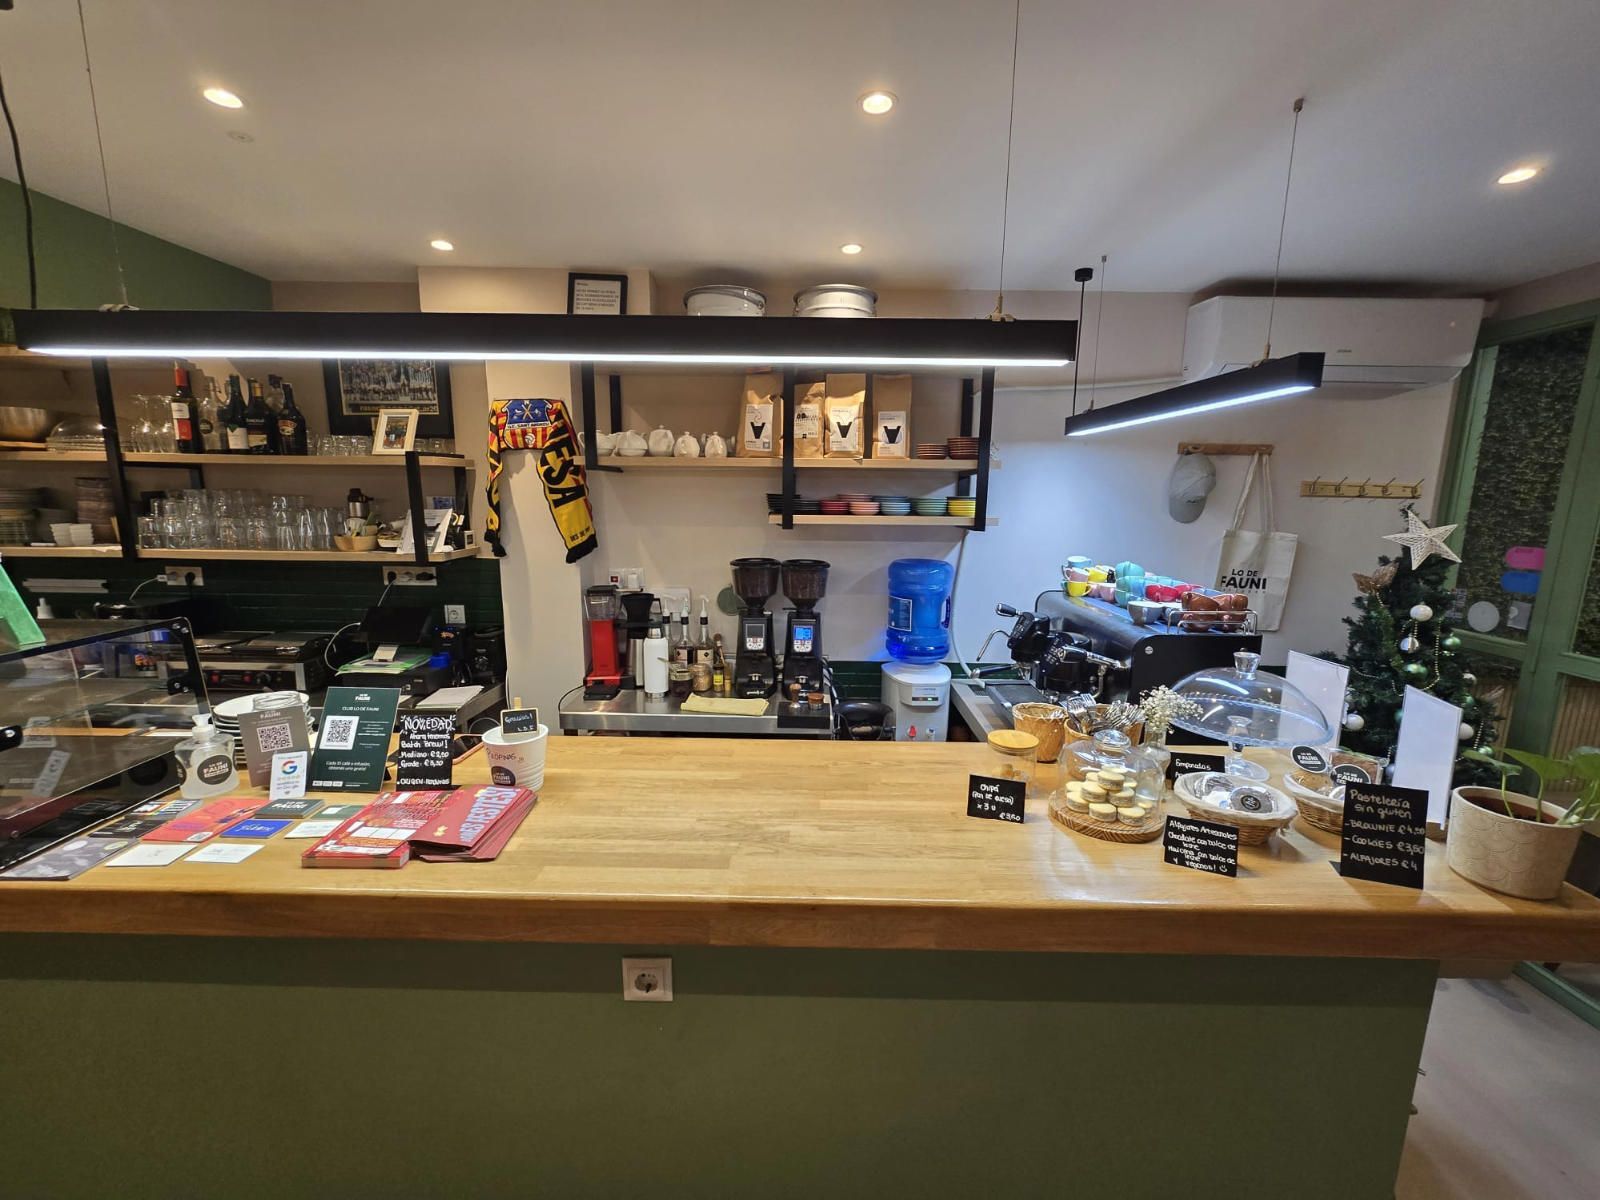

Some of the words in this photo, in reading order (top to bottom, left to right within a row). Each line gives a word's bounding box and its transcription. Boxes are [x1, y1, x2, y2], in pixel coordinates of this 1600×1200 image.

[1231, 568, 1244, 576] LO
[1220, 575, 1267, 590] FAUNI
[404, 717, 454, 731] NOVEDAD
[1337, 773, 1363, 783] FAUNI
